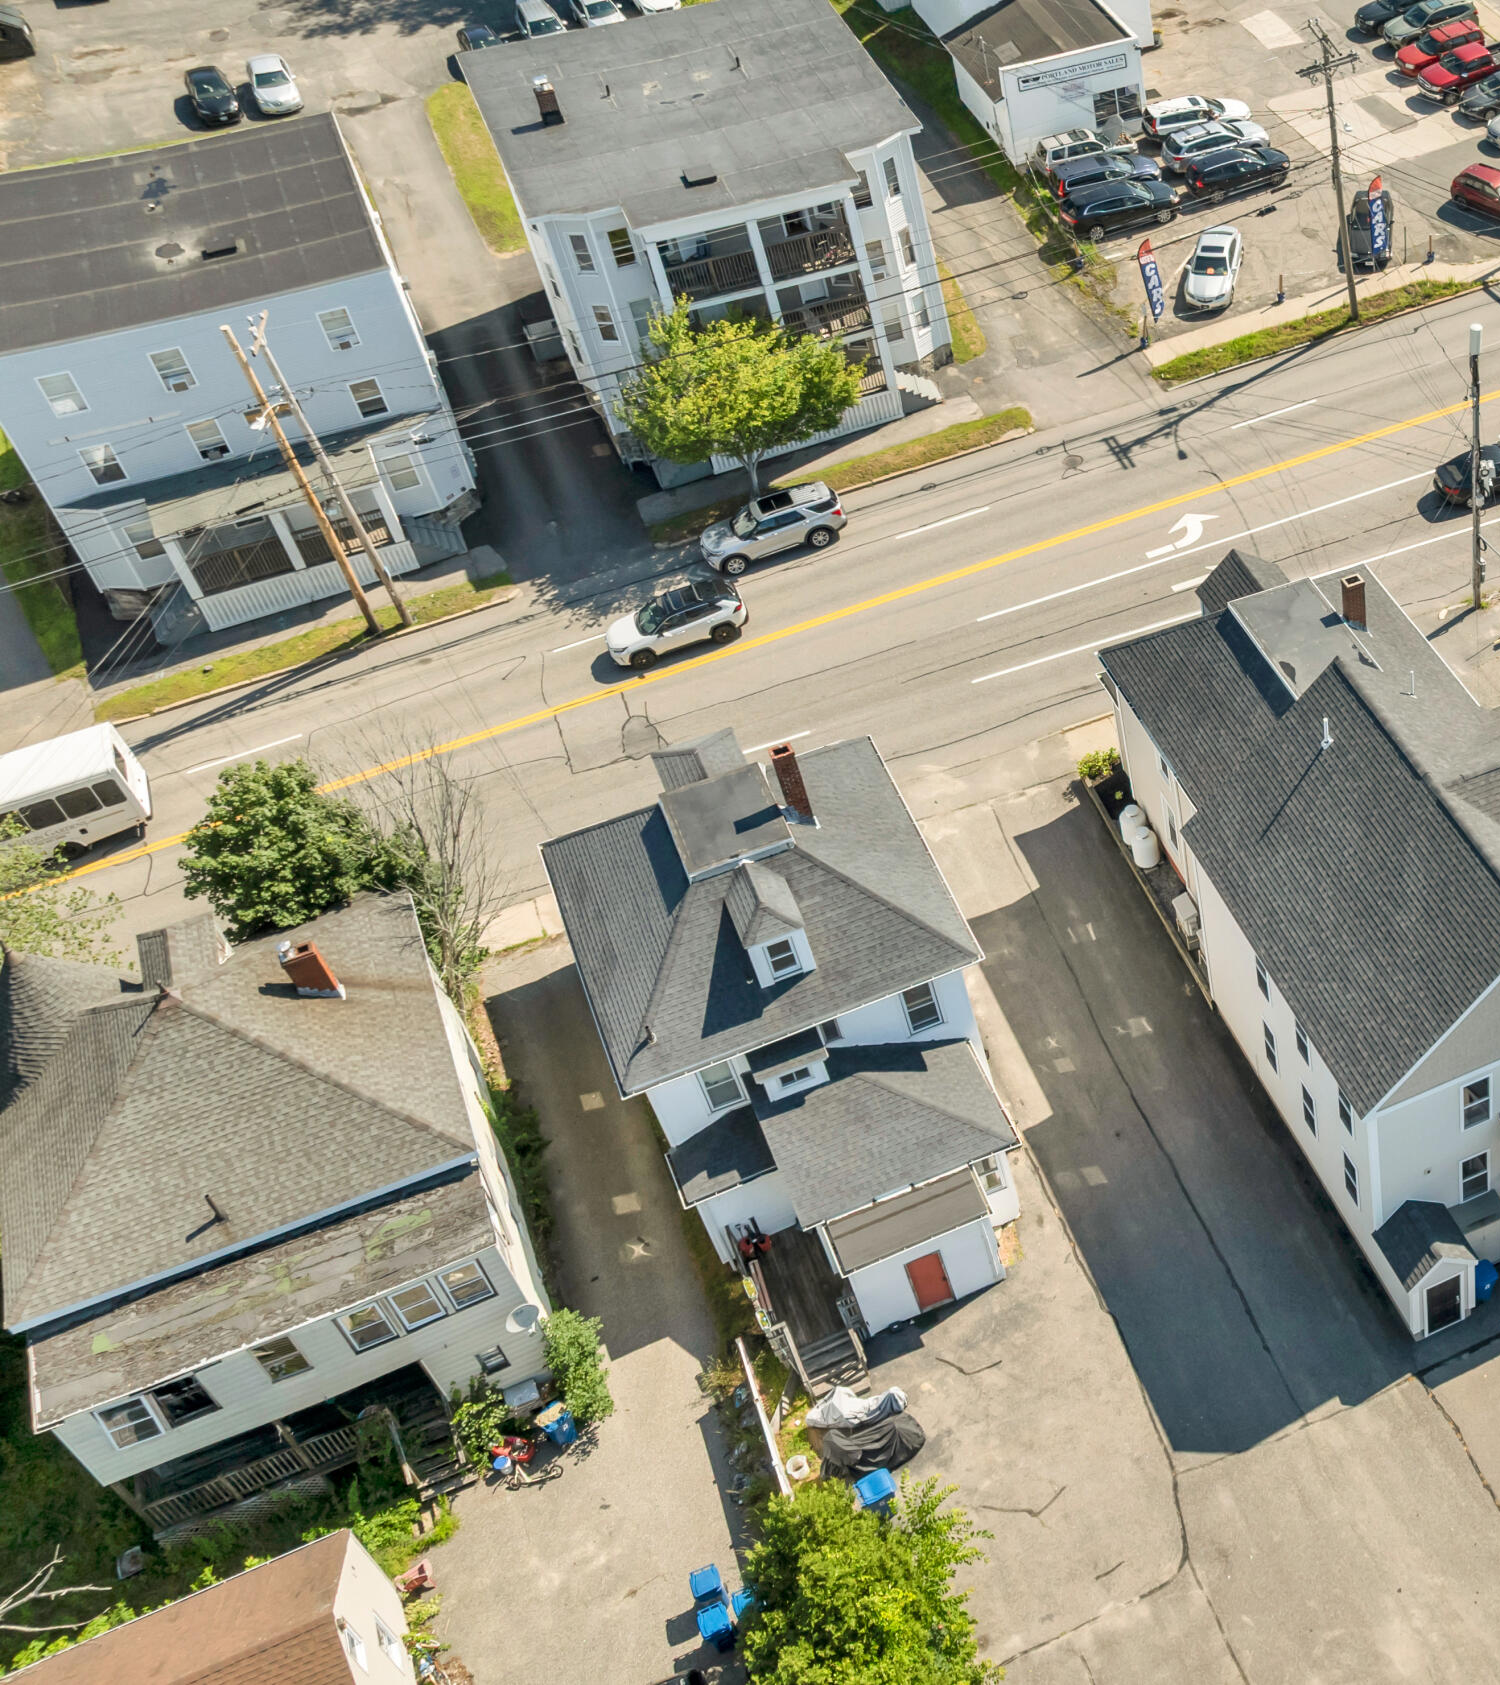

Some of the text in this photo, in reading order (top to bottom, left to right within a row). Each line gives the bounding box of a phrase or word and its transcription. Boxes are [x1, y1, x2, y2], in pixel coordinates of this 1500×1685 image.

[1041, 67, 1078, 81] PORTLAND
[1078, 62, 1103, 72] MOTOR
[1103, 58, 1124, 66] SALES
[1372, 199, 1386, 248] CARS
[1145, 263, 1163, 315] CARS
